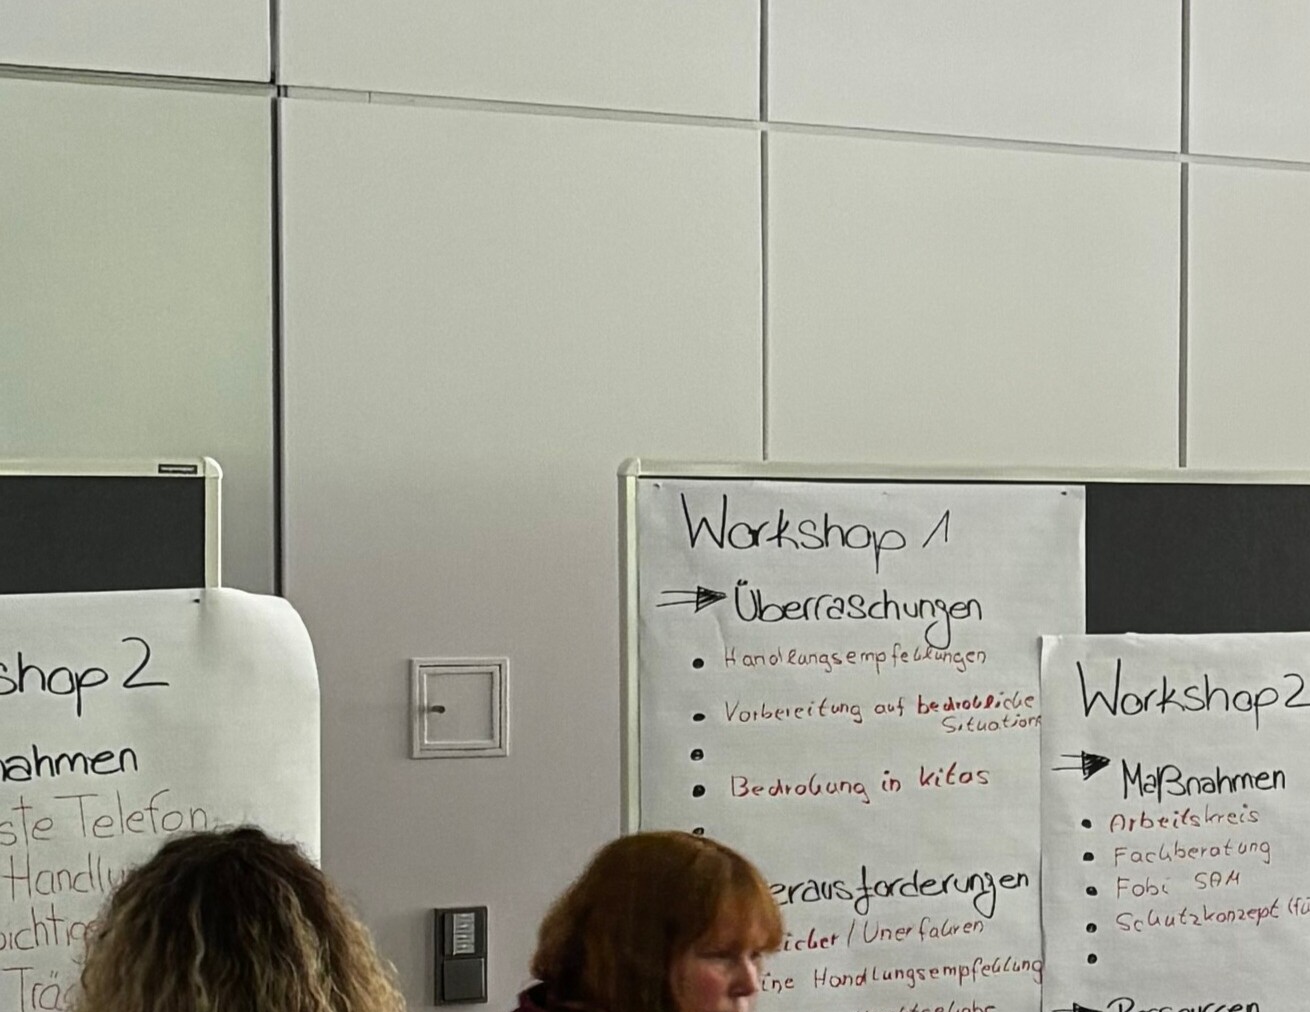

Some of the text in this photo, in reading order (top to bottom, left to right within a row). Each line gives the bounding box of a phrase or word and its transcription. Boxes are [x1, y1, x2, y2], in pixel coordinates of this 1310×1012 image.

[680, 492, 951, 575] Workshop 1
[734, 578, 984, 650] Überraschungen
[0, 637, 169, 717] shop 2
[1075, 657, 1280, 731] Workshop
[724, 700, 863, 724] Vorbereitung
[874, 699, 905, 717] auf
[731, 774, 872, 805] Bedrohung
[880, 770, 902, 794] in
[1121, 758, 1287, 803] Maßnahmen
[0, 797, 54, 847] ste
[1109, 803, 1260, 834] Arbeitskreis
[1114, 840, 1272, 867] Fachberatung
[2, 852, 125, 902] Handlu
[767, 865, 1030, 920] erausforderungen
[1116, 869, 1240, 899] Fobi SAM
[1115, 897, 1280, 934] Schutzkonzept
[761, 956, 1046, 995] ine Handlungsempfehlung
